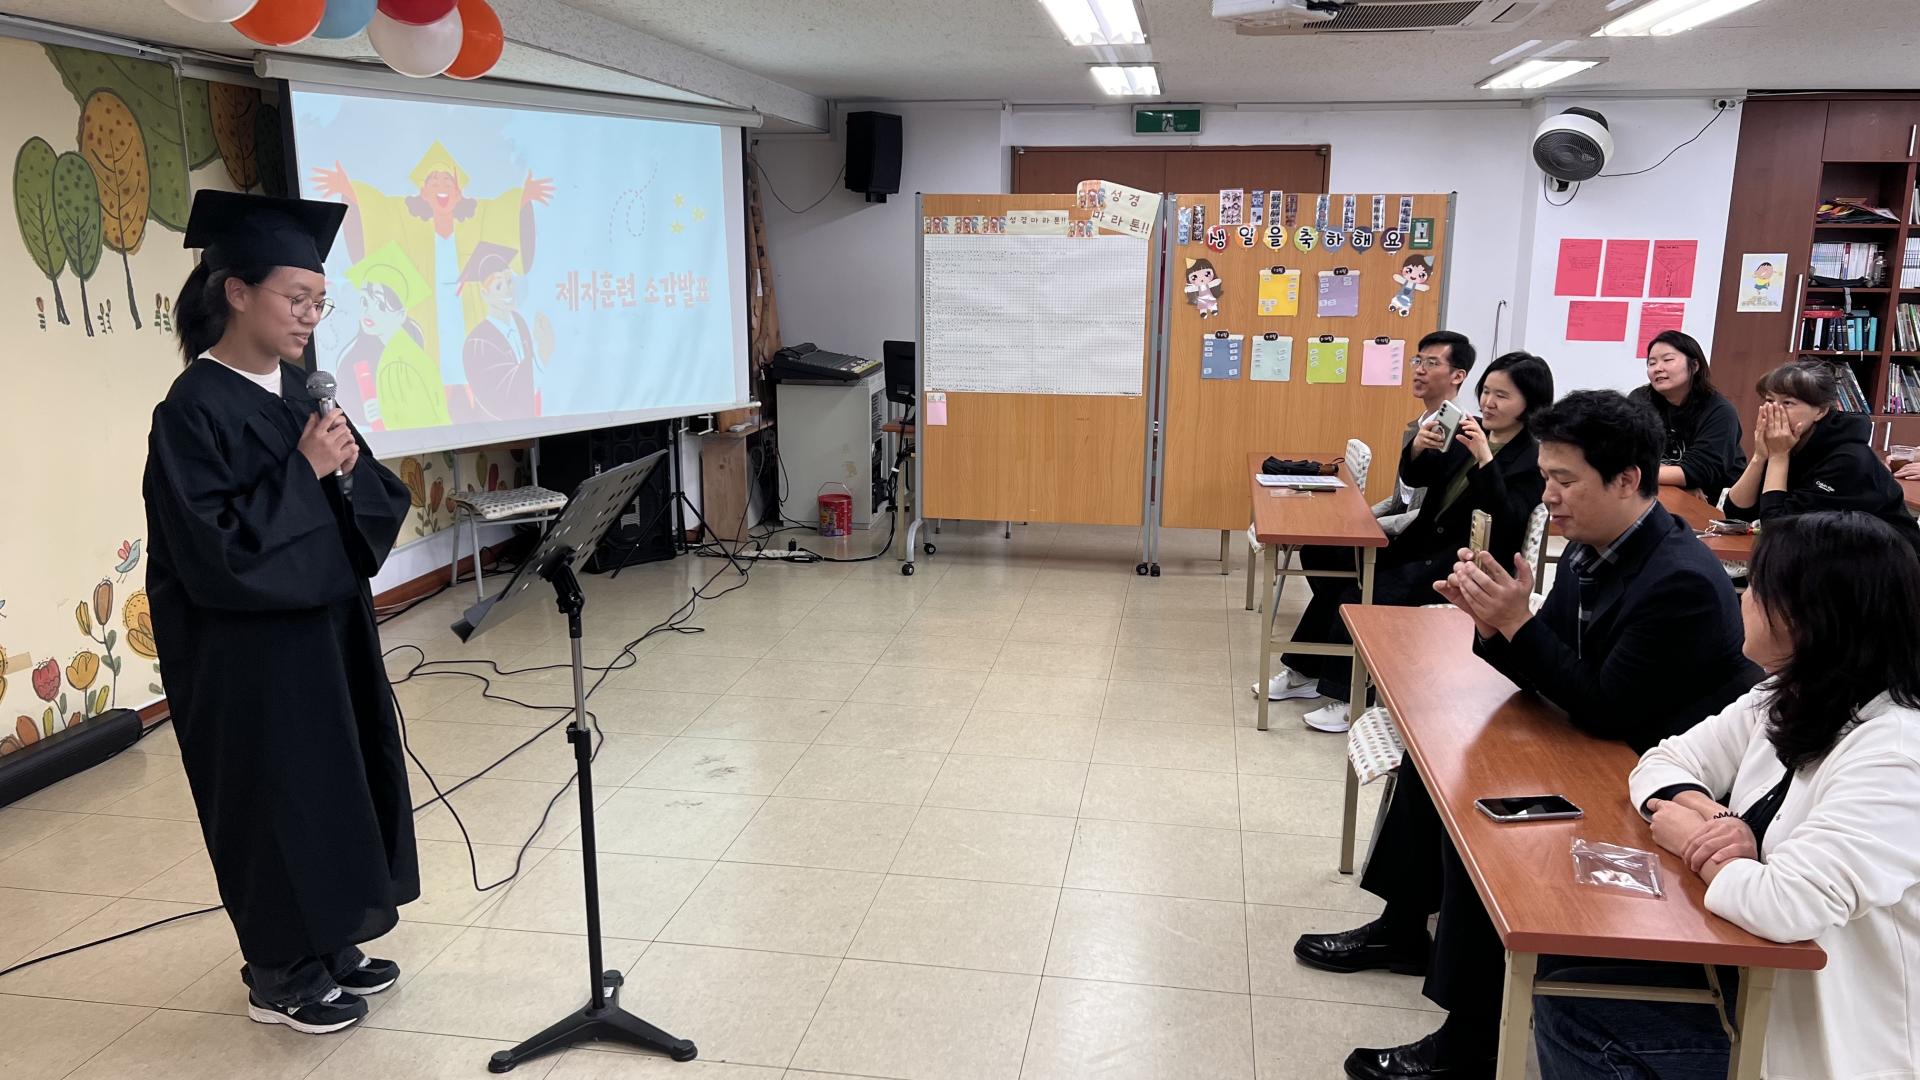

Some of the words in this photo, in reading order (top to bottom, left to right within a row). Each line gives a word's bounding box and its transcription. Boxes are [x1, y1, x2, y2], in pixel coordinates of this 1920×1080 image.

[1111, 190, 1140, 207] 성경
[555, 270, 638, 312] 제자훈련
[644, 270, 711, 309] 소감발표
